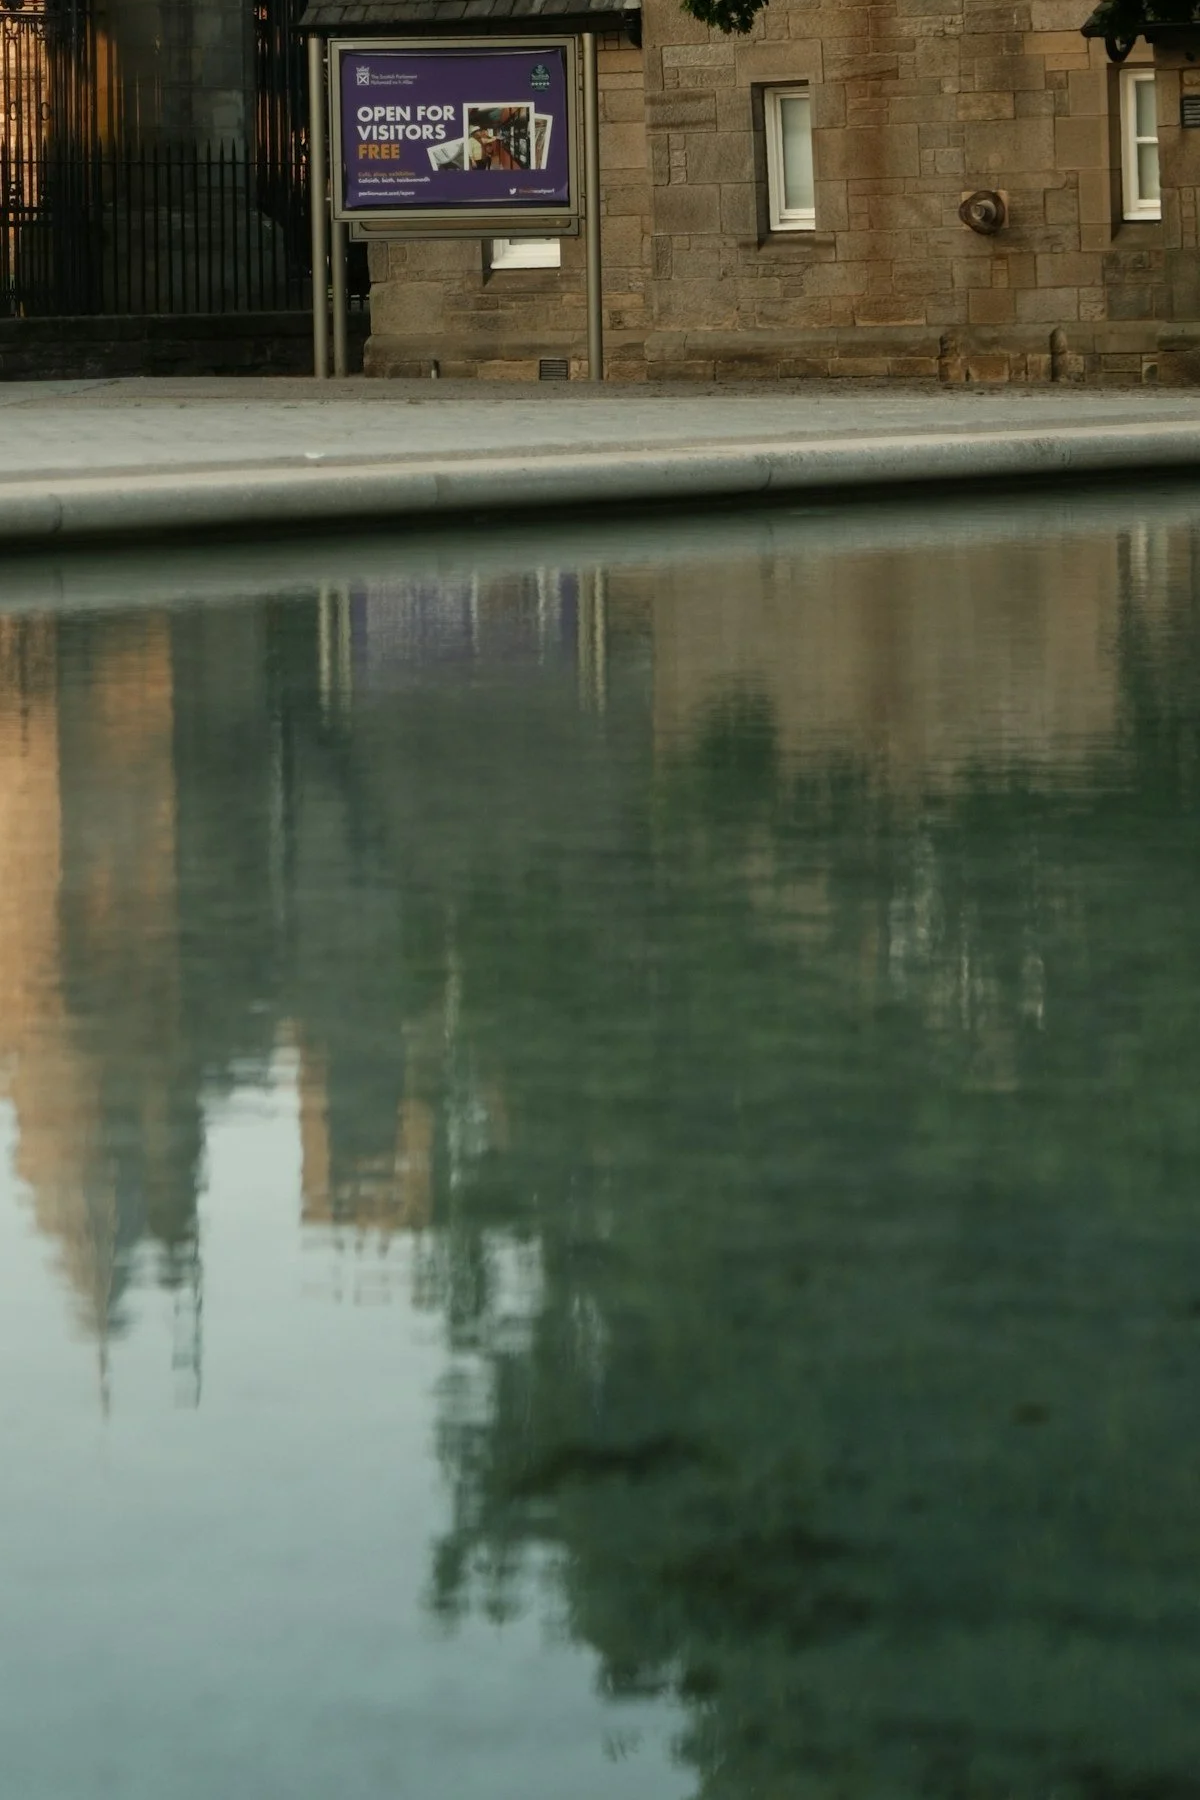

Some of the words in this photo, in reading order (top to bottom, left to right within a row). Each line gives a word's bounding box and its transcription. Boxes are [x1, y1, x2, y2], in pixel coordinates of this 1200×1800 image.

[357, 106, 411, 122] OPEN
[416, 105, 456, 121] FOR
[357, 124, 446, 140] VISITORS
[358, 143, 400, 160] FREE
